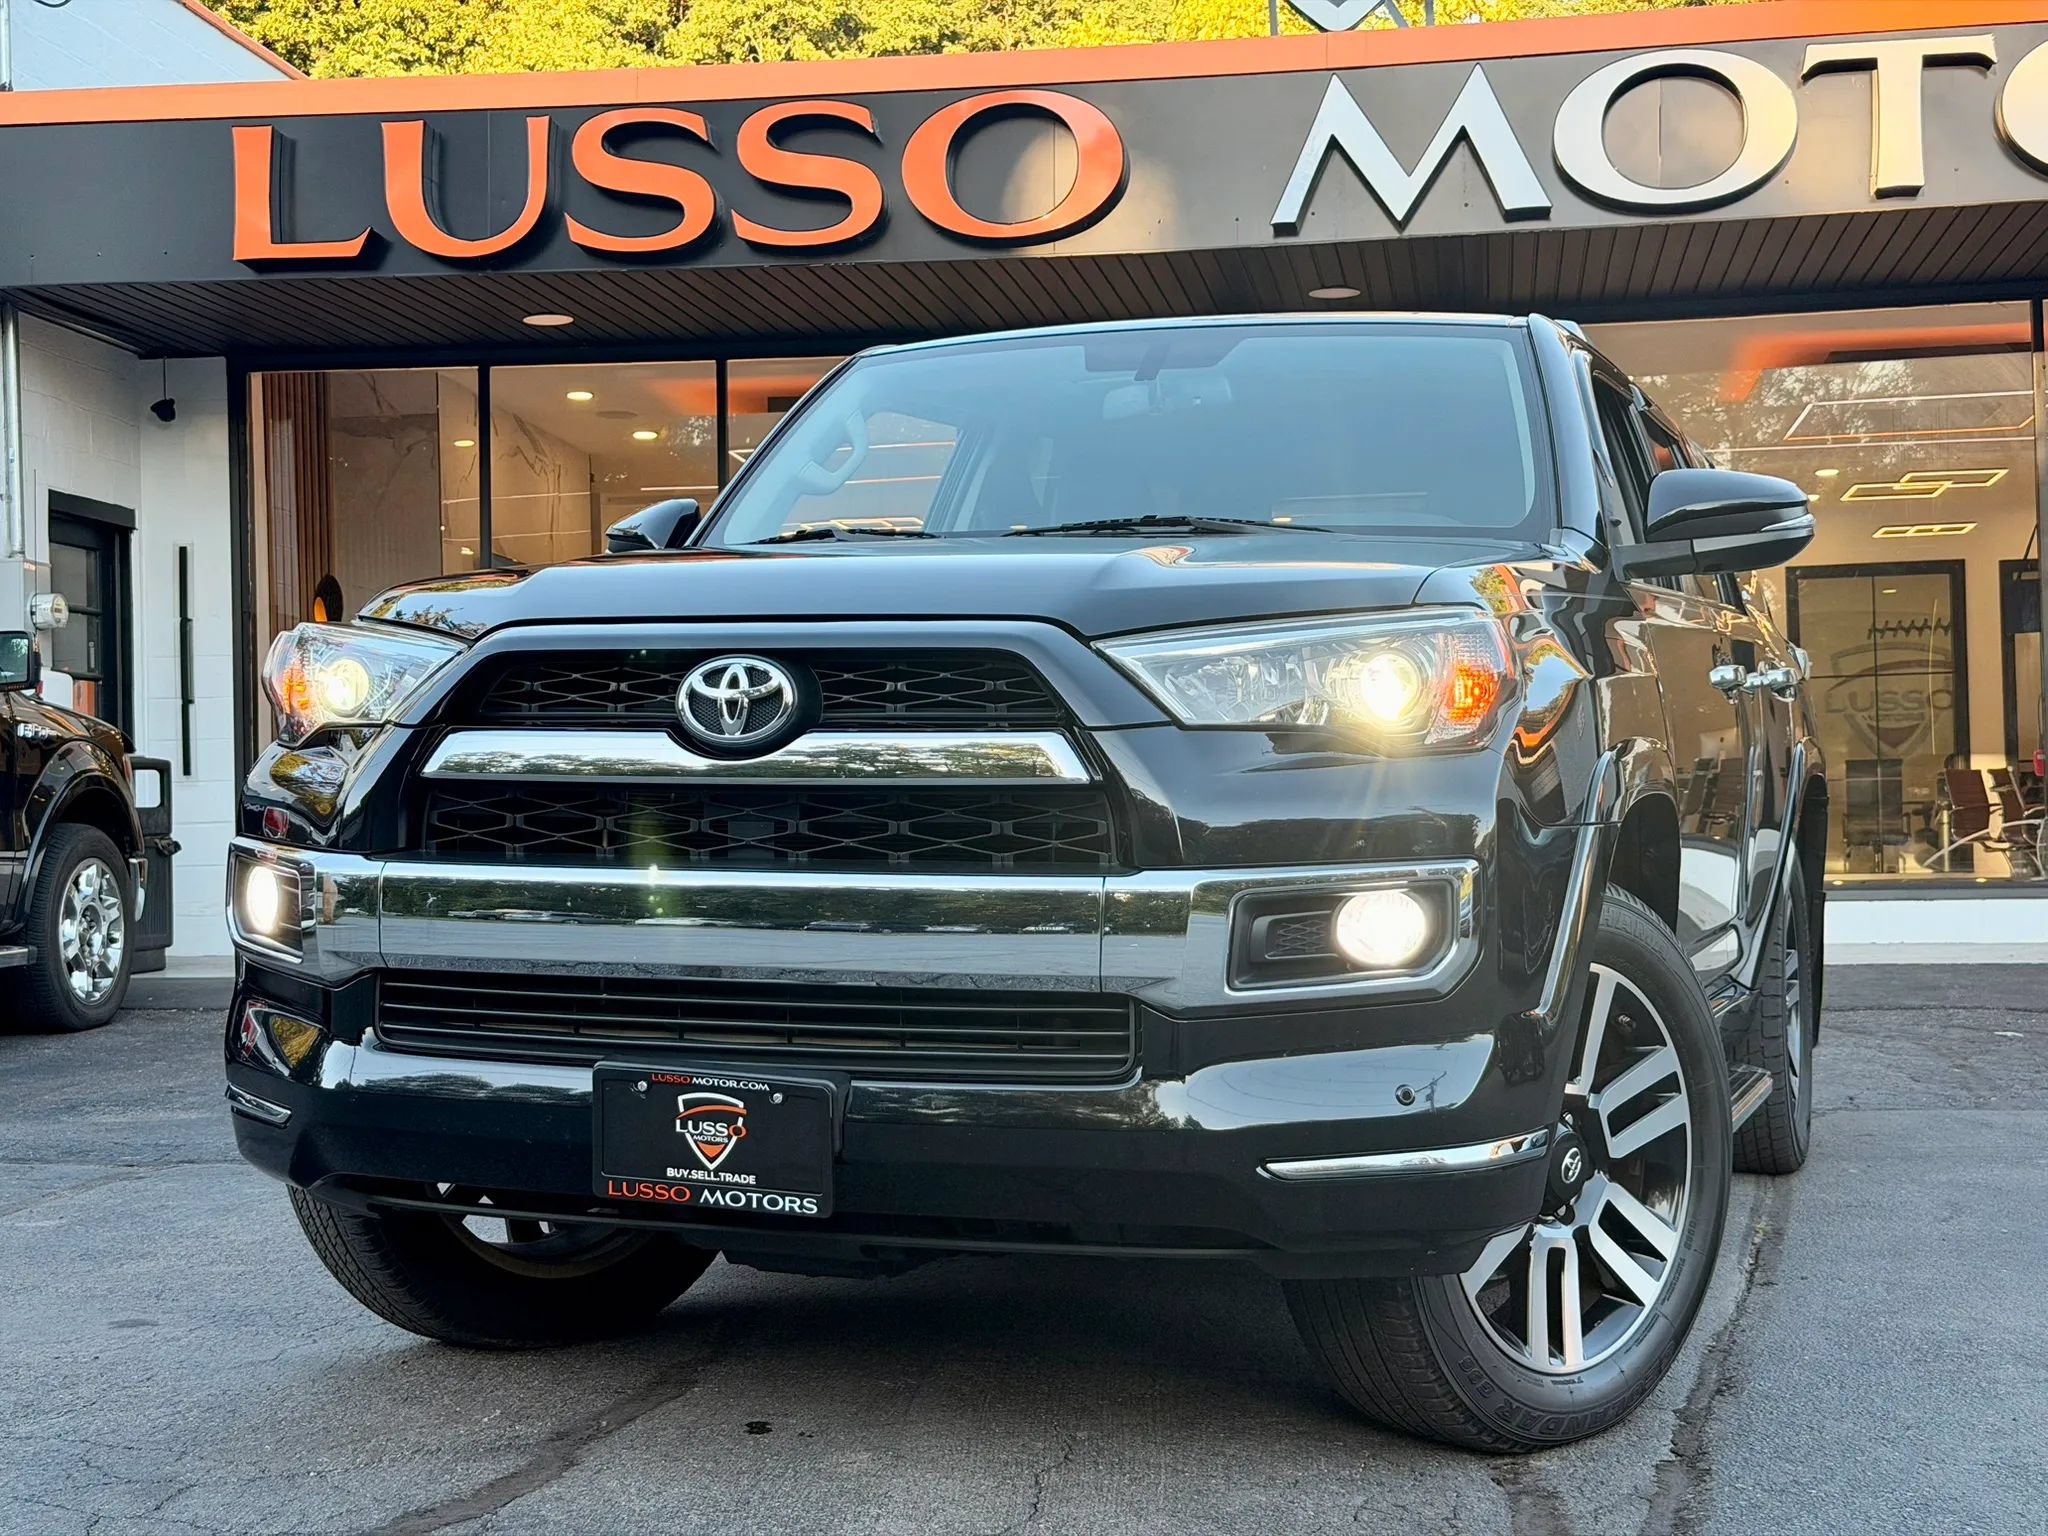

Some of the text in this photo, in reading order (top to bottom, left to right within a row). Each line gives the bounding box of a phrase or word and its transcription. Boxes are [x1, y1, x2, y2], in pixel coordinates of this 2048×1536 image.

[231, 34, 2048, 262] LUSSO MOT
[676, 1119, 747, 1138] LUSSO
[693, 1134, 729, 1143] MOTORS
[667, 1167, 757, 1185] BUY.SELL.TRADE
[608, 1180, 818, 1214] LUSSO MOTORS
